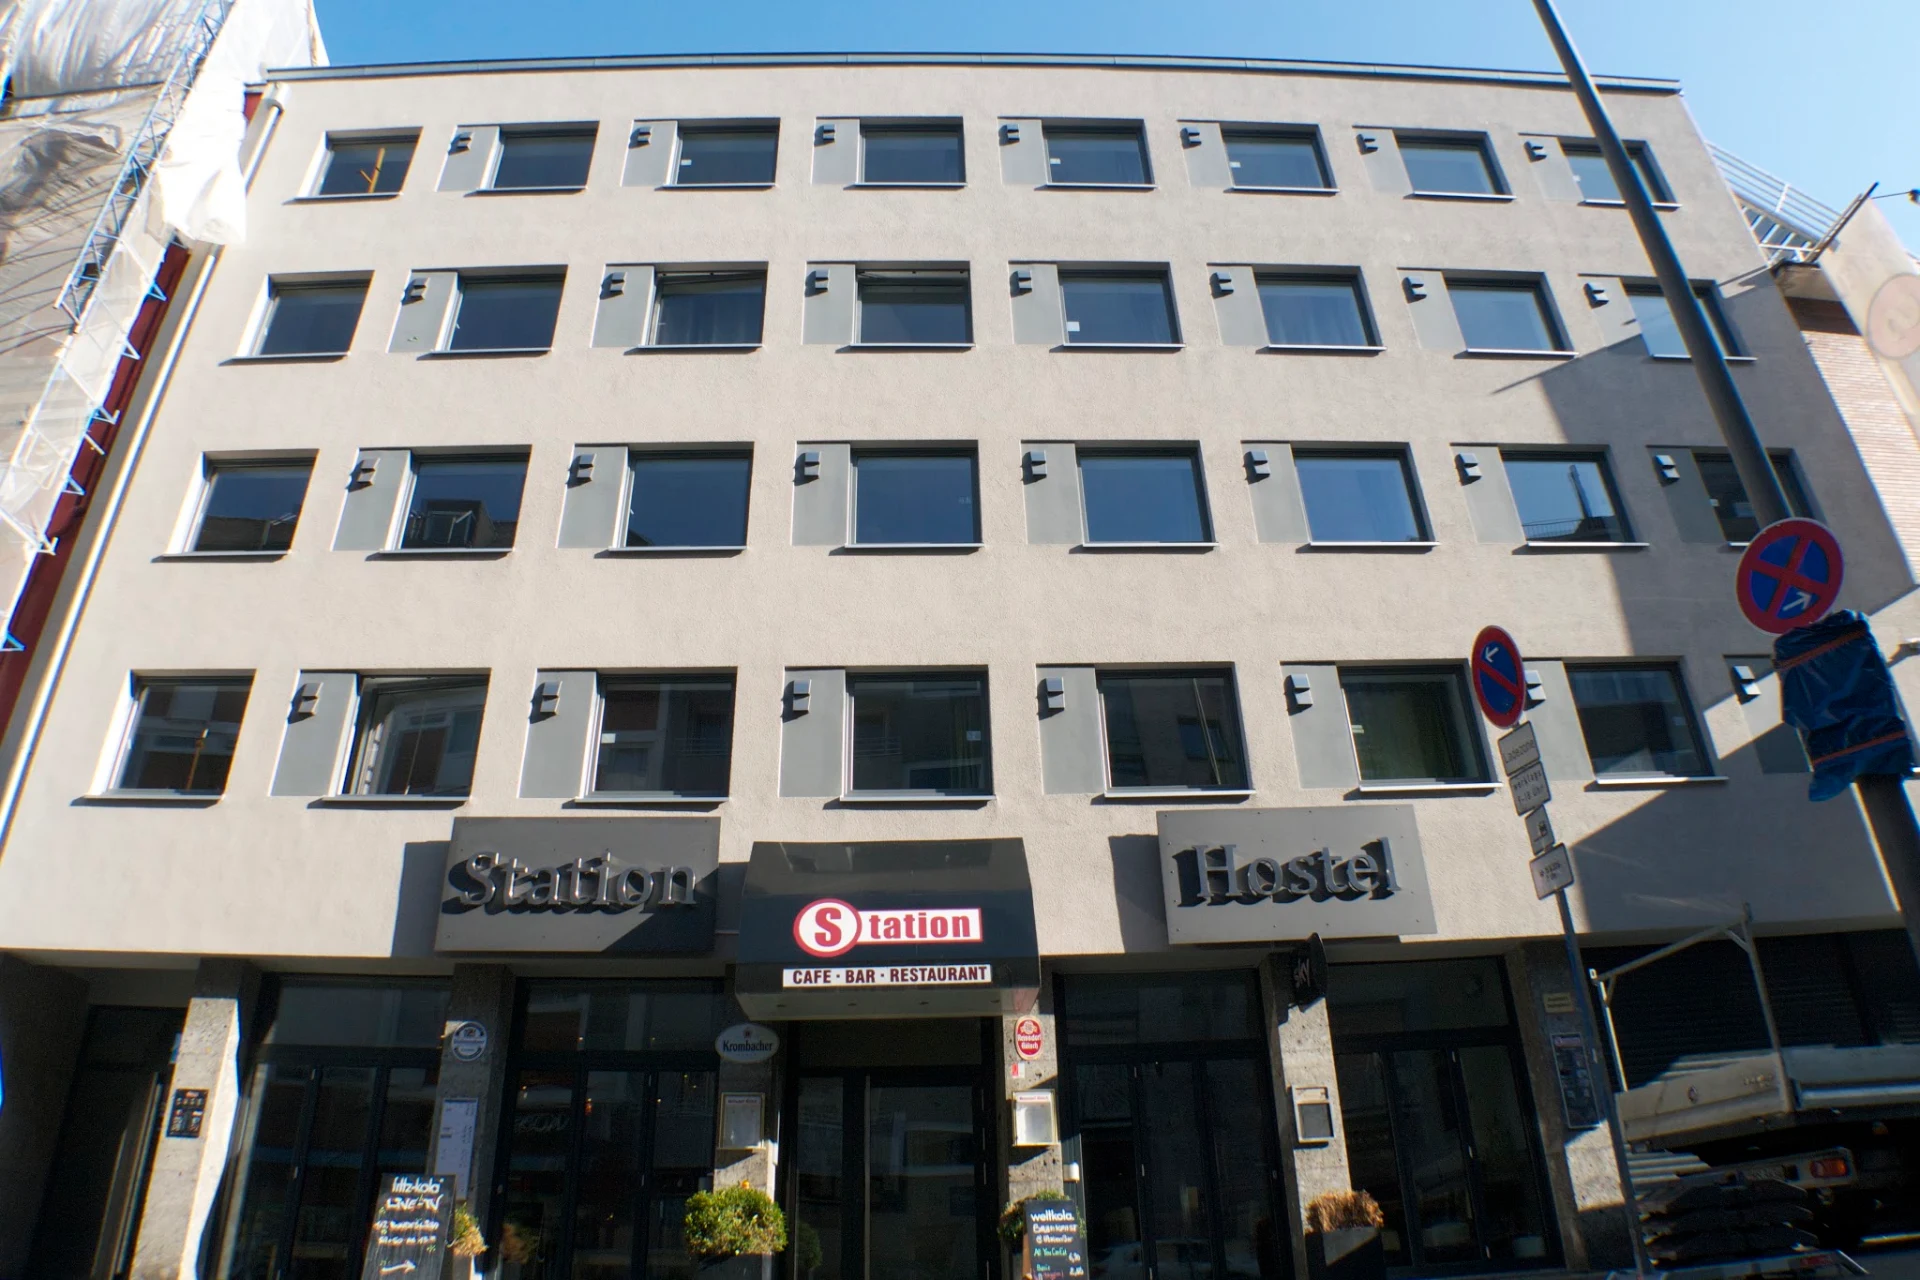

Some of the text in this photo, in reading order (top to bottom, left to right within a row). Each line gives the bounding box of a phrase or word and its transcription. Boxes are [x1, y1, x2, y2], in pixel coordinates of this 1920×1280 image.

[1504, 739, 1536, 763] Ladezone
[459, 851, 698, 906] Station
[1191, 836, 1402, 897] Hostel
[814, 906, 971, 947] Station
[793, 966, 988, 984] CAFE BAR RESTAURANT
[722, 1040, 773, 1052] Krombacher
